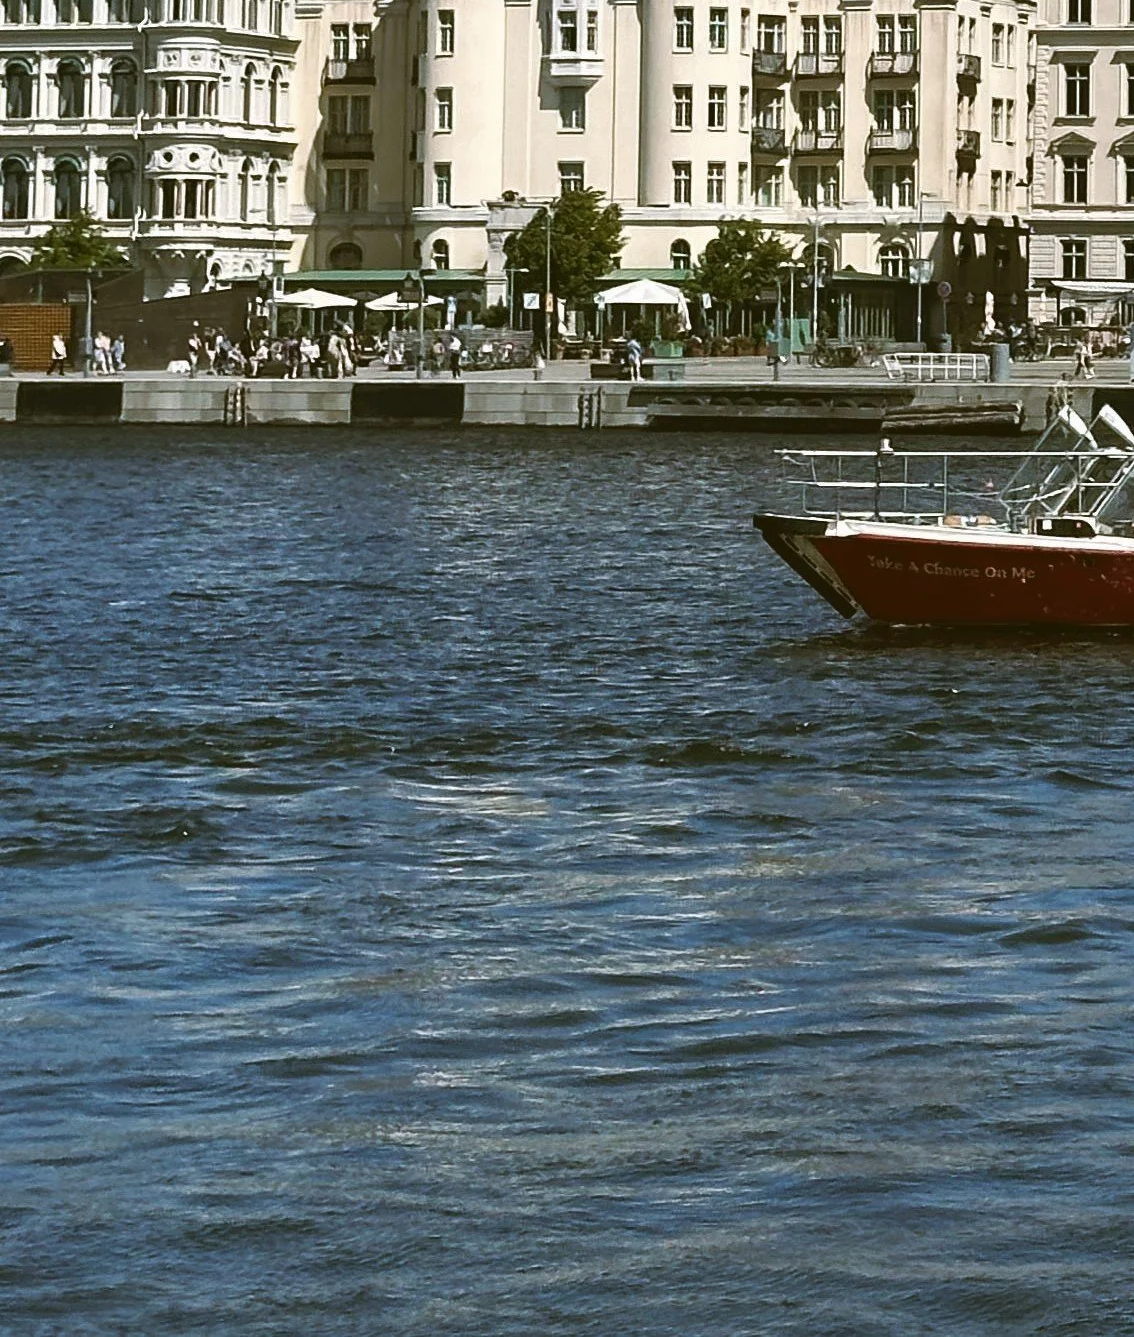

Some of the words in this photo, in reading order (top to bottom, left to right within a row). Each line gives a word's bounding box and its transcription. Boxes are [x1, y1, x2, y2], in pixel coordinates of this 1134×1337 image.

[908, 561, 920, 573] A
[923, 561, 980, 578] Chance
[985, 566, 1008, 579] On
[1012, 567, 1036, 580] Me
